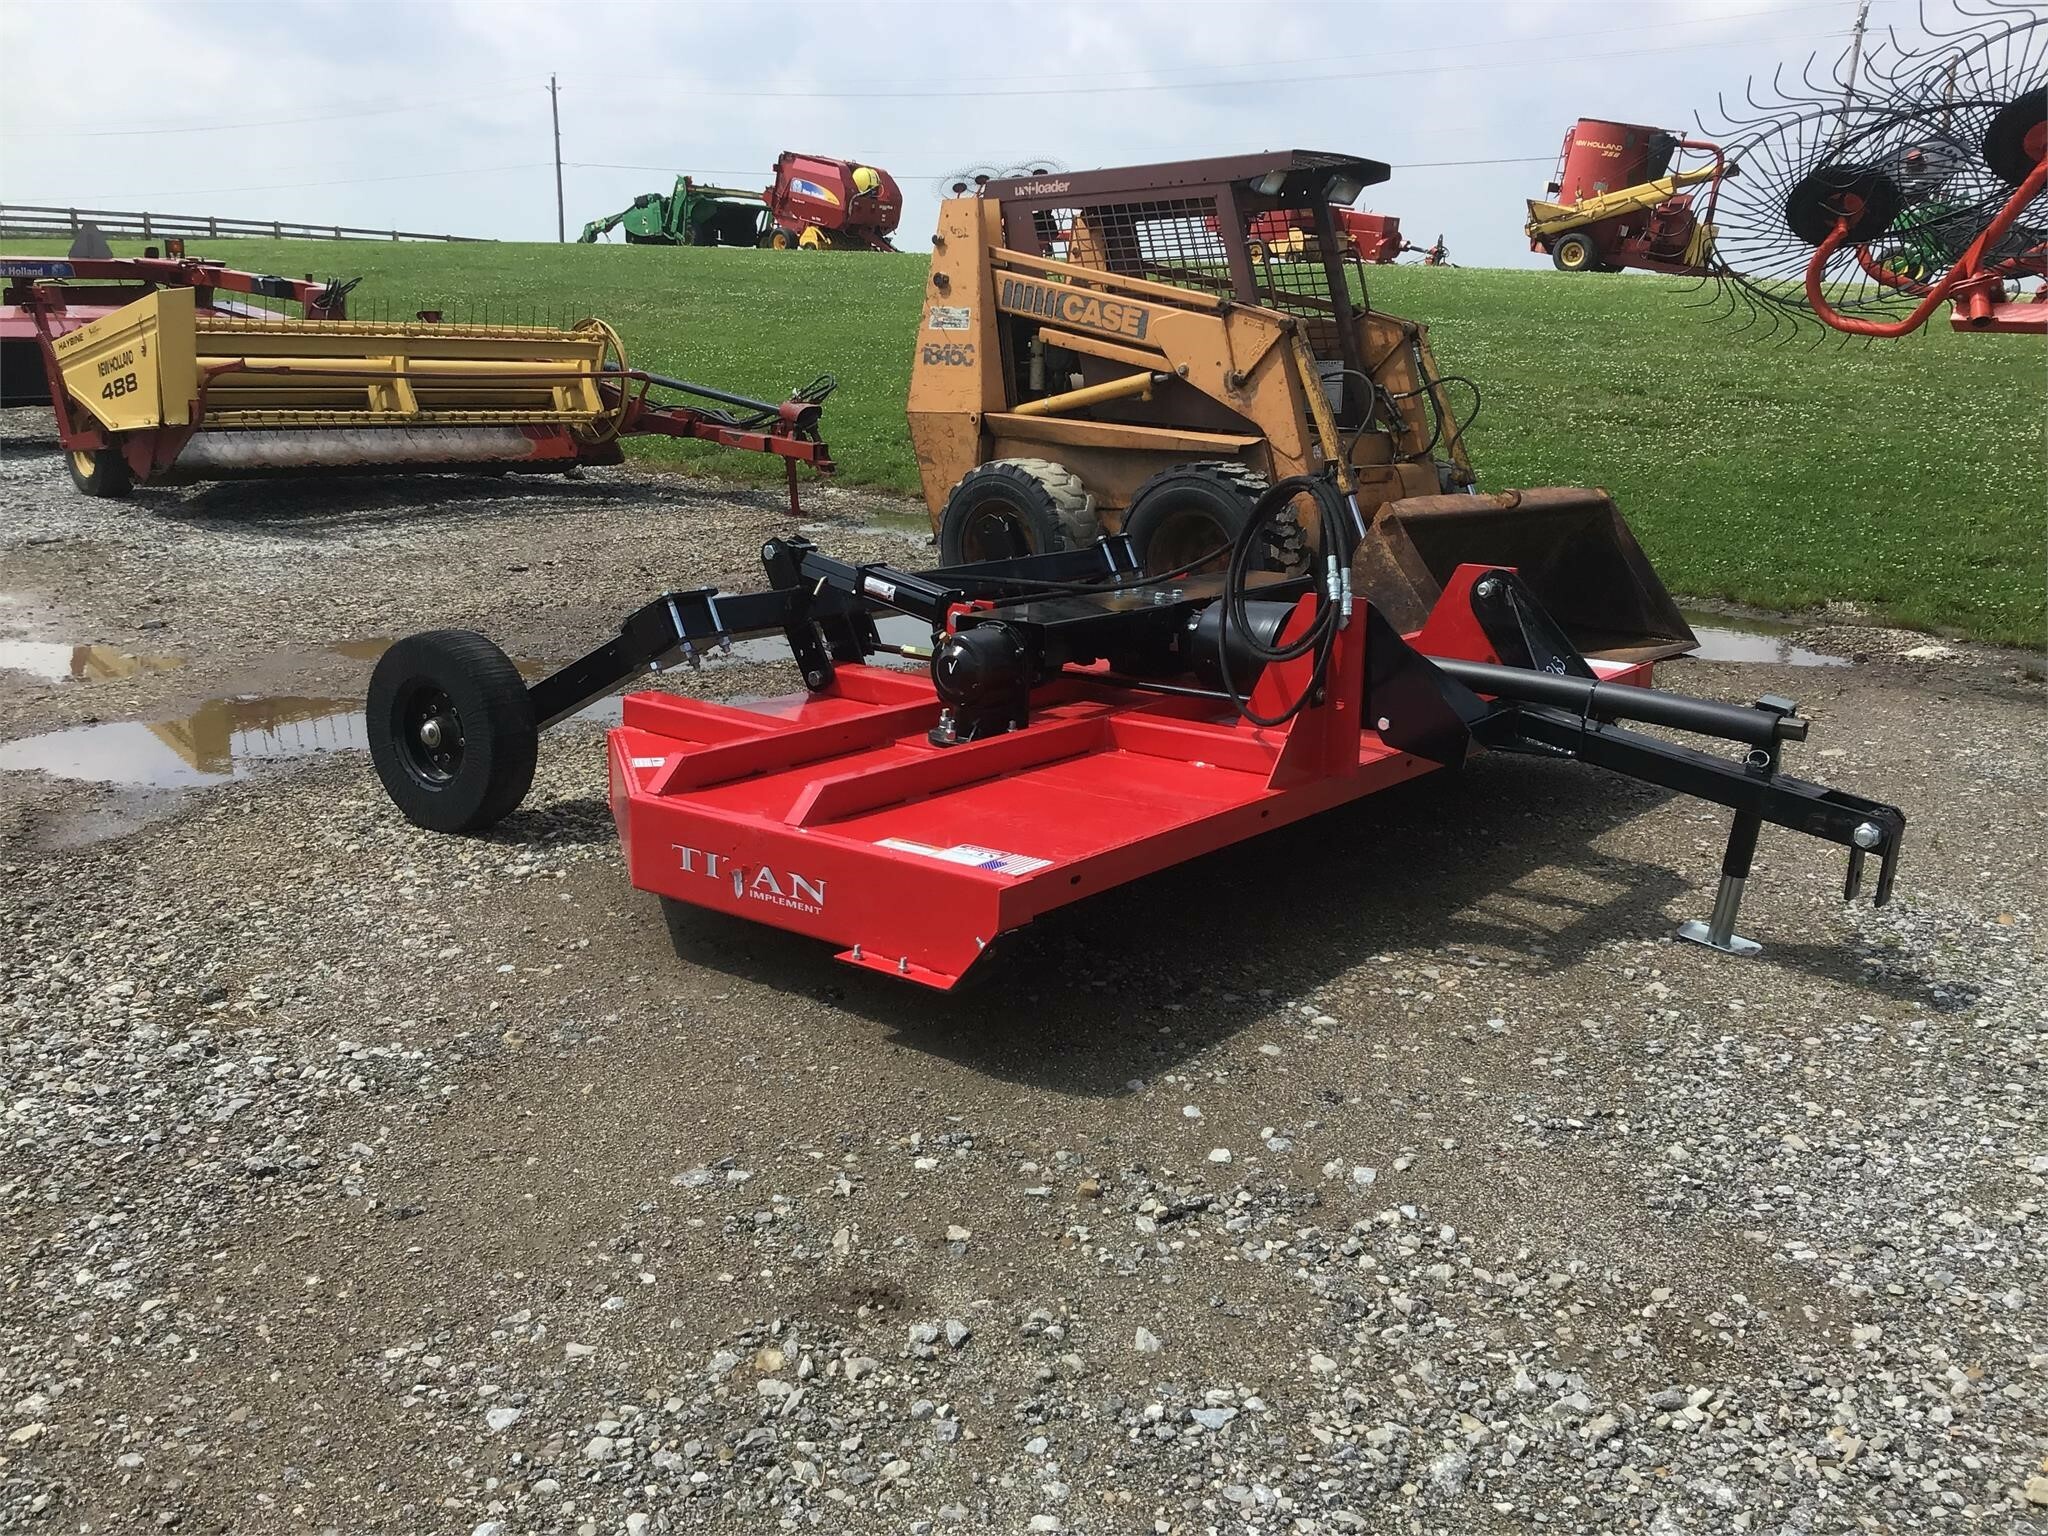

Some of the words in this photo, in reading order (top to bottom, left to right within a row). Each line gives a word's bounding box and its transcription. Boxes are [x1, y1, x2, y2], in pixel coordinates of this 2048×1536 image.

[1587, 141, 1623, 151] HOLLAND
[1014, 180, 1071, 197] uni-loader
[8, 266, 44, 276] Holland
[1062, 294, 1143, 337] CASE
[101, 372, 138, 400] 488
[749, 890, 822, 915] IMPLEMENT
